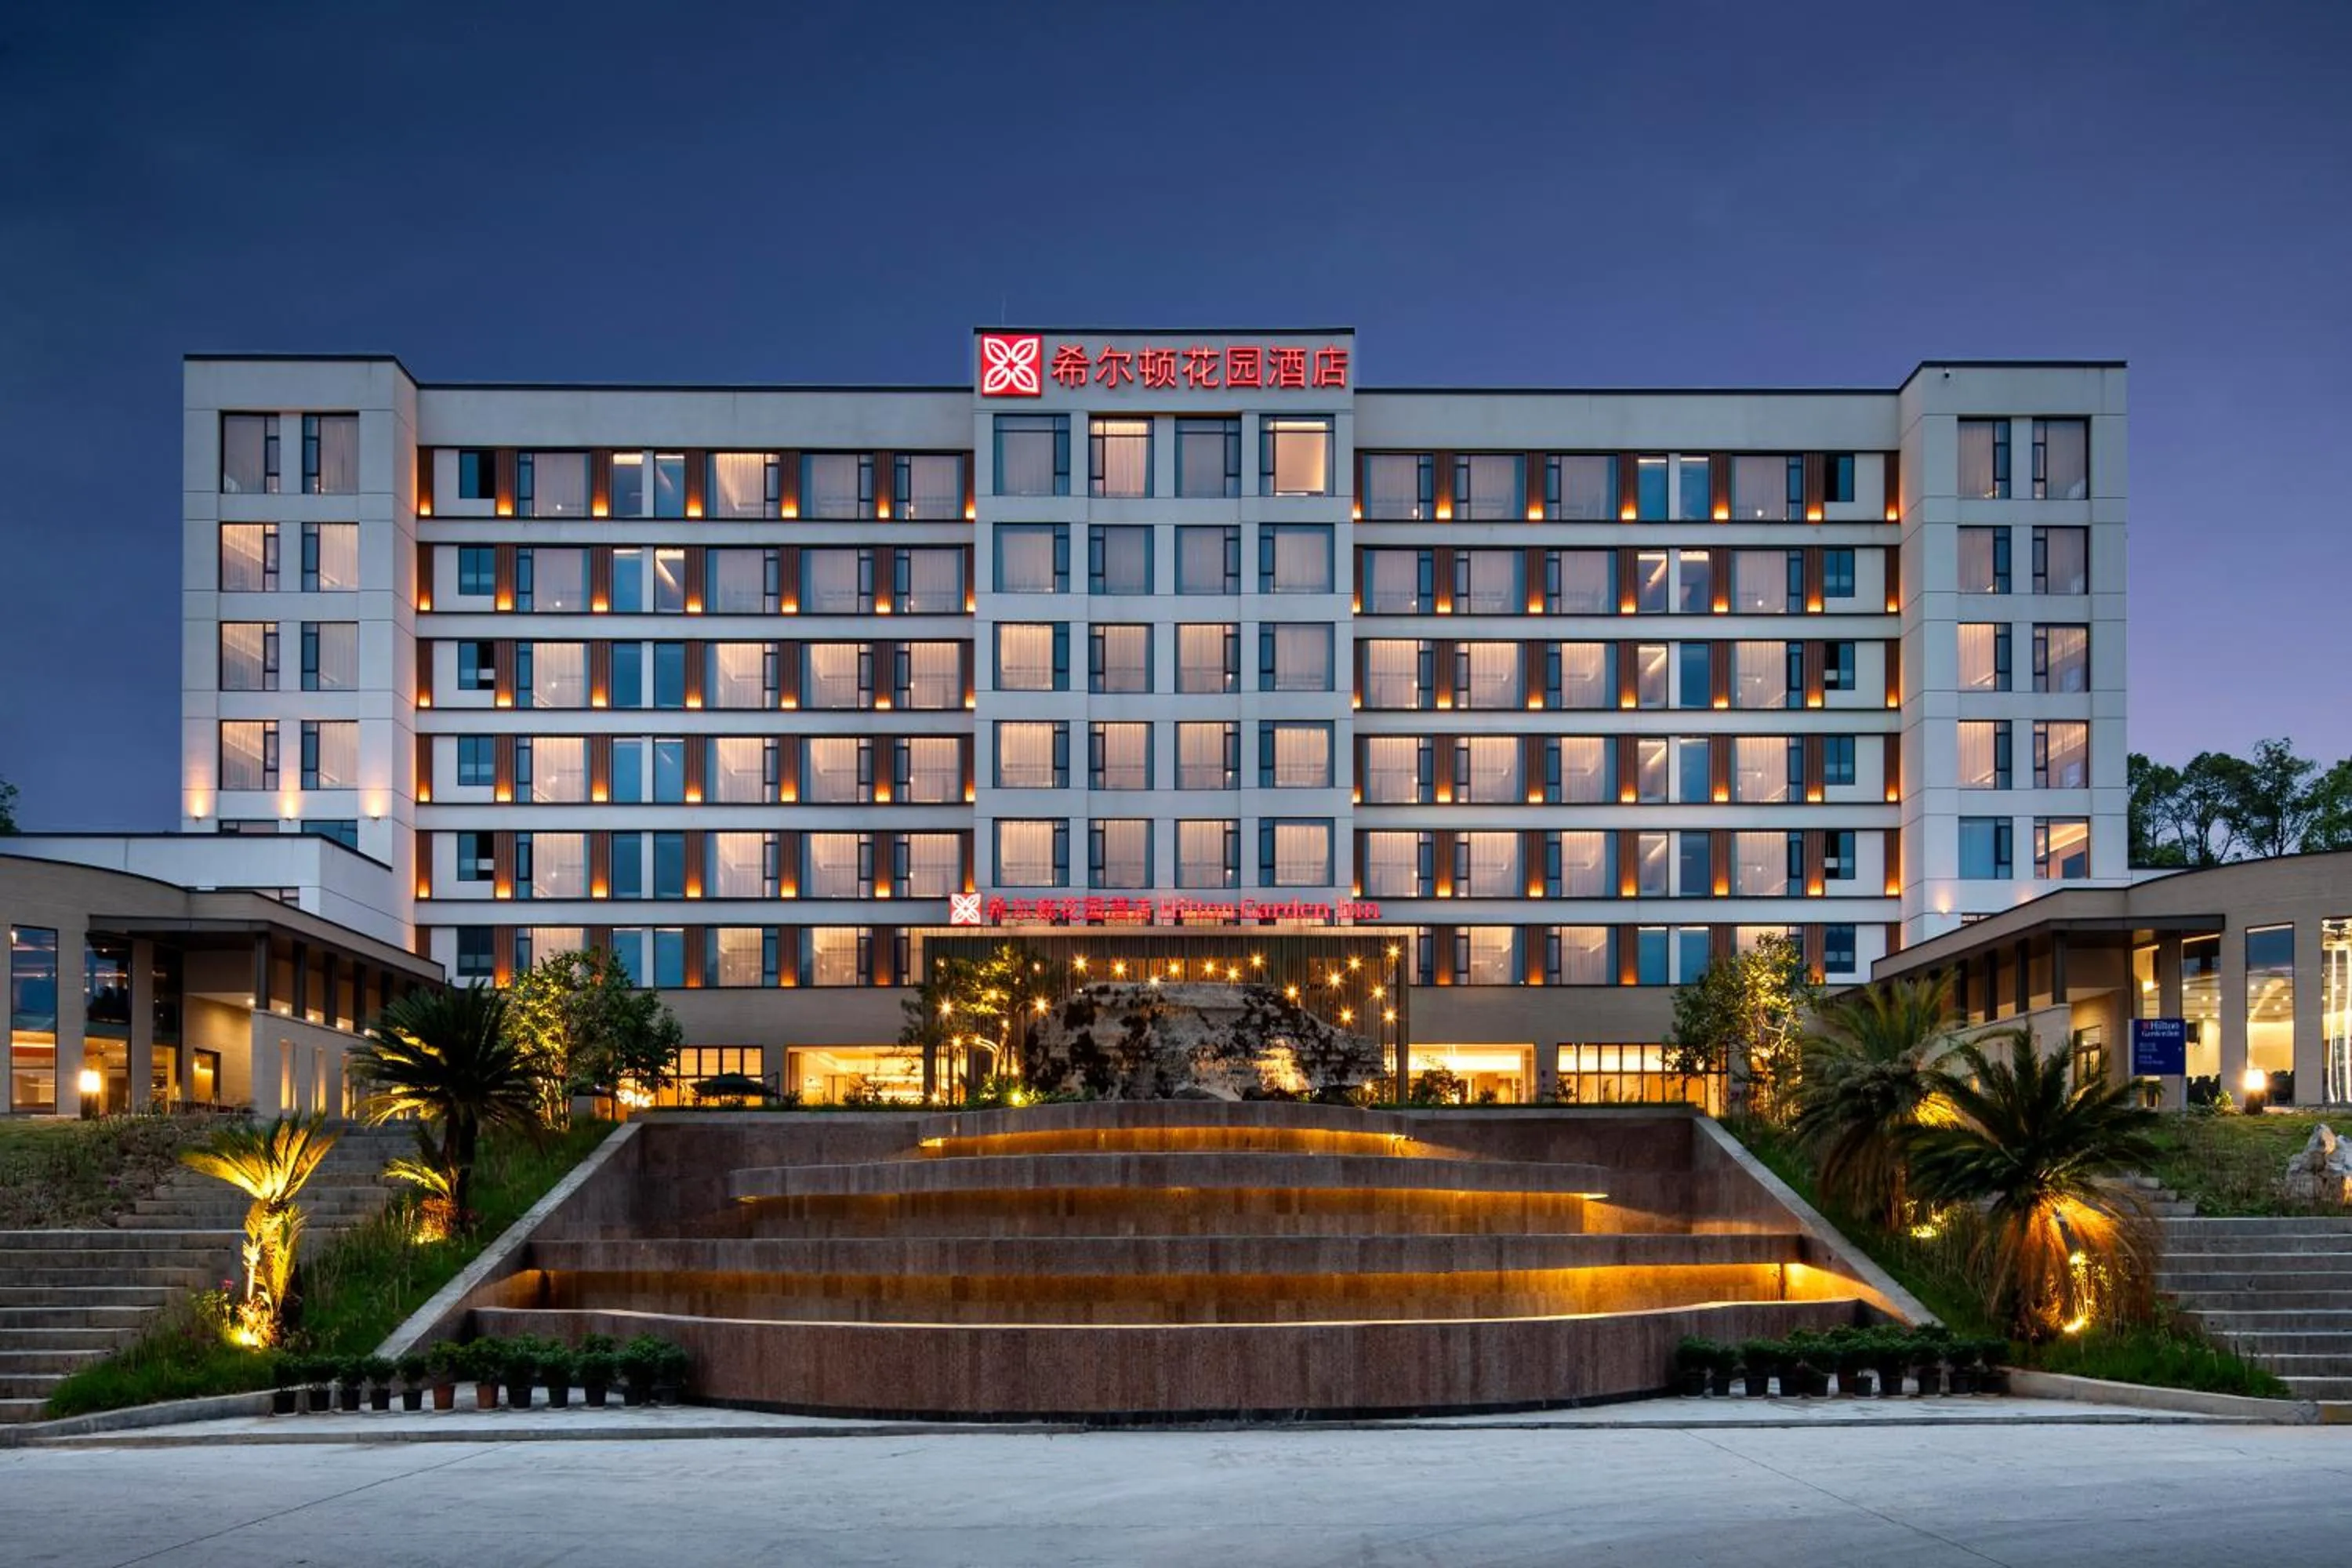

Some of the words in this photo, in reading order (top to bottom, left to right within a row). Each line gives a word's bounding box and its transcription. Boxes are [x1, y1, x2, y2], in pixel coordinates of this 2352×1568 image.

[1051, 344, 1348, 388] 希尔顿花园酒店
[1160, 896, 1235, 919] Hilton
[1240, 898, 1330, 919] Garden
[1337, 898, 1381, 919] Inn
